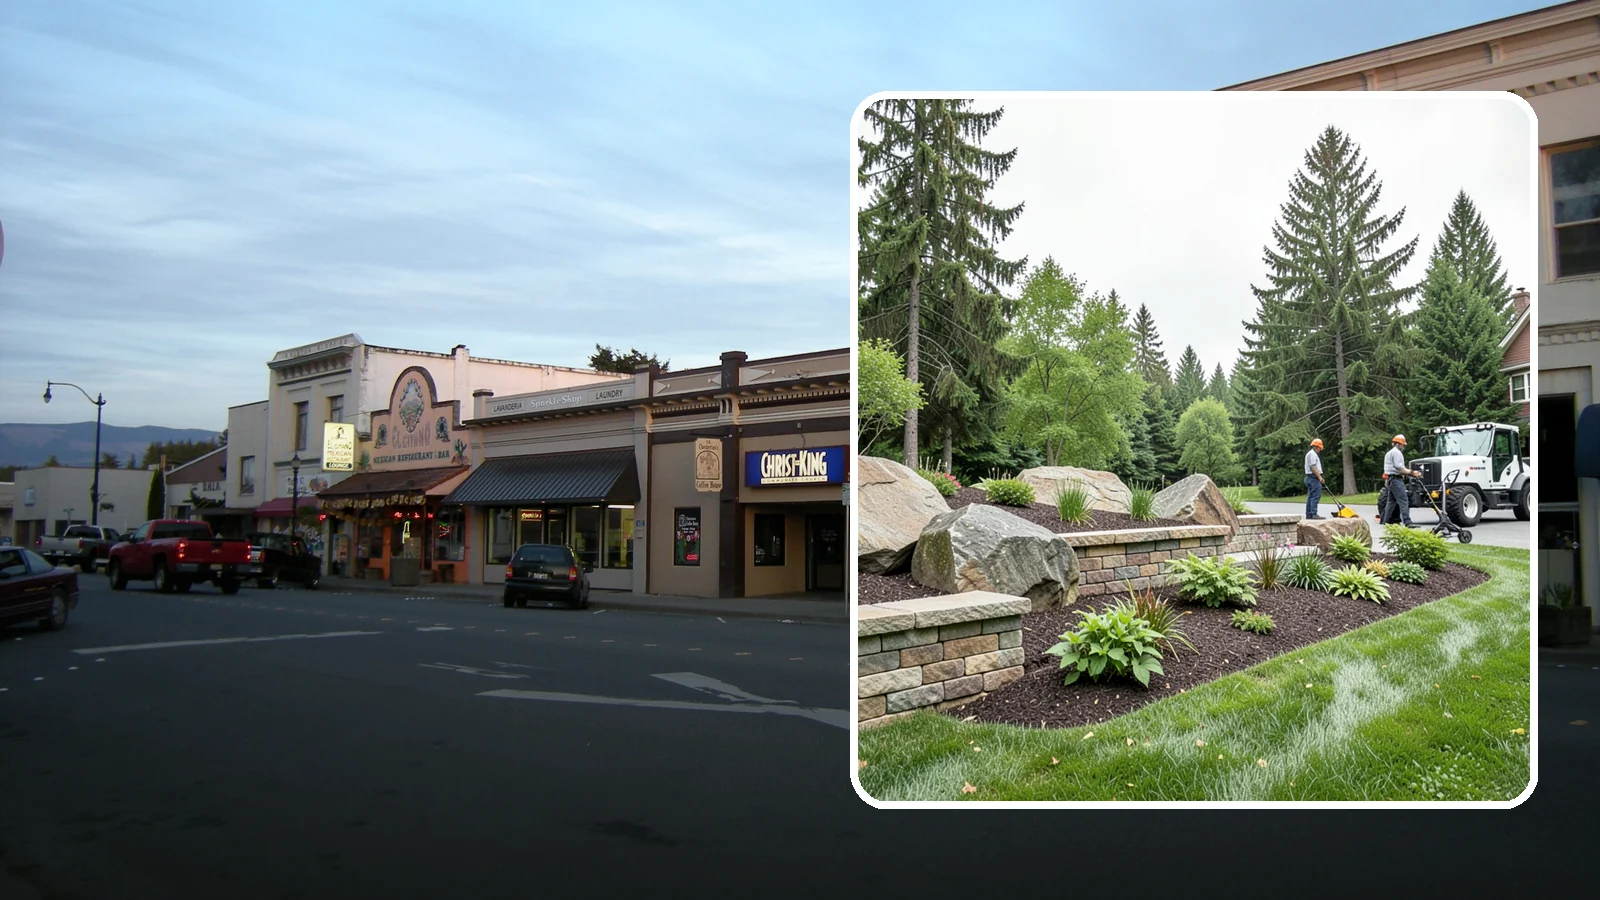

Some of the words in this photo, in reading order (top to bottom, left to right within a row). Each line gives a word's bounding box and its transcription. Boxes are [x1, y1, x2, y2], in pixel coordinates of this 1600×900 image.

[562, 394, 582, 404] Shop
[595, 389, 623, 400] LAUNDRY
[493, 402, 522, 413] LAVANDERIA
[373, 455, 396, 464] MEXICAN
[397, 451, 433, 462] RESTAURANT
[438, 450, 450, 459] BAR
